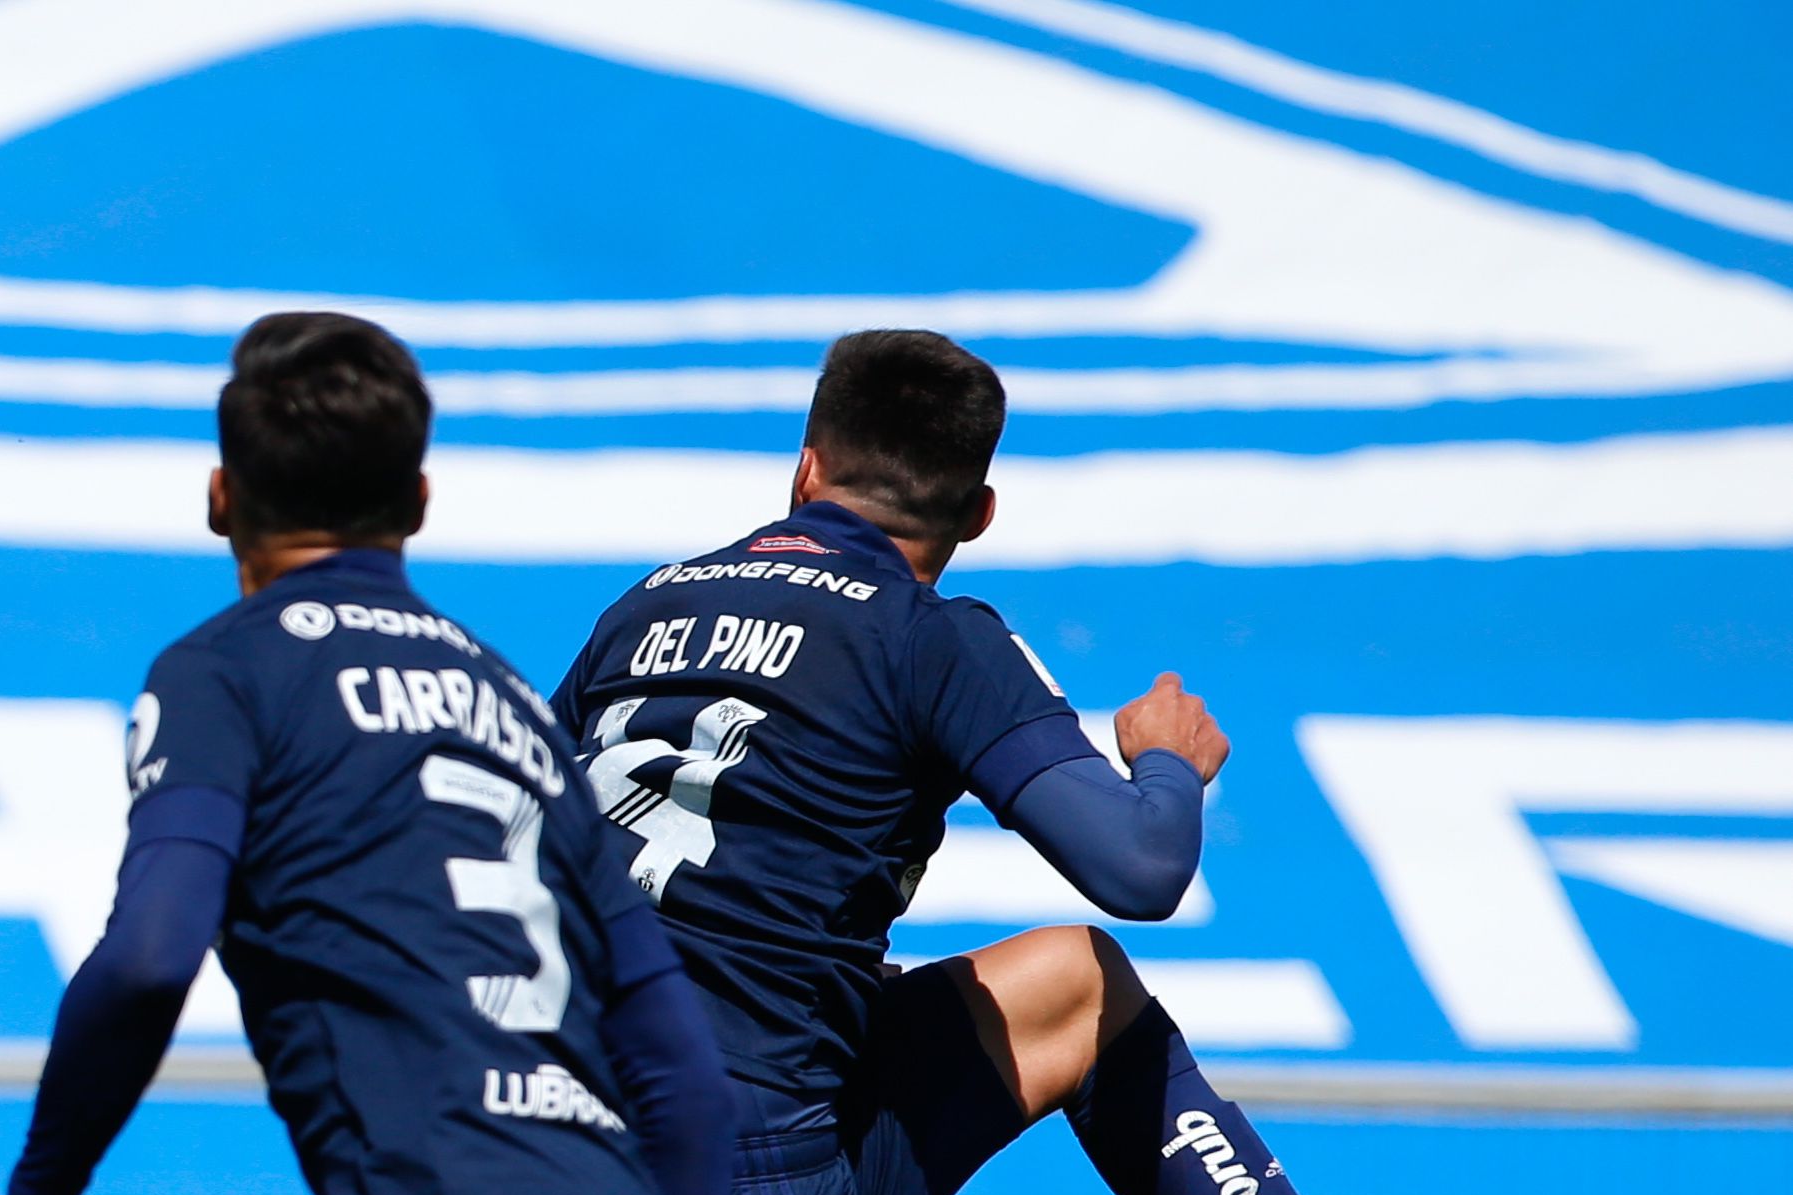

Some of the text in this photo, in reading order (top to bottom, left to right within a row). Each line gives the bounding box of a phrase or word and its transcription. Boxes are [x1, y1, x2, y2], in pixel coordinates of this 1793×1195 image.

[670, 560, 879, 603] DONGFENG
[629, 613, 806, 679] DEL PINO
[336, 665, 566, 799] CARRASCO
[417, 753, 573, 1034] 3
